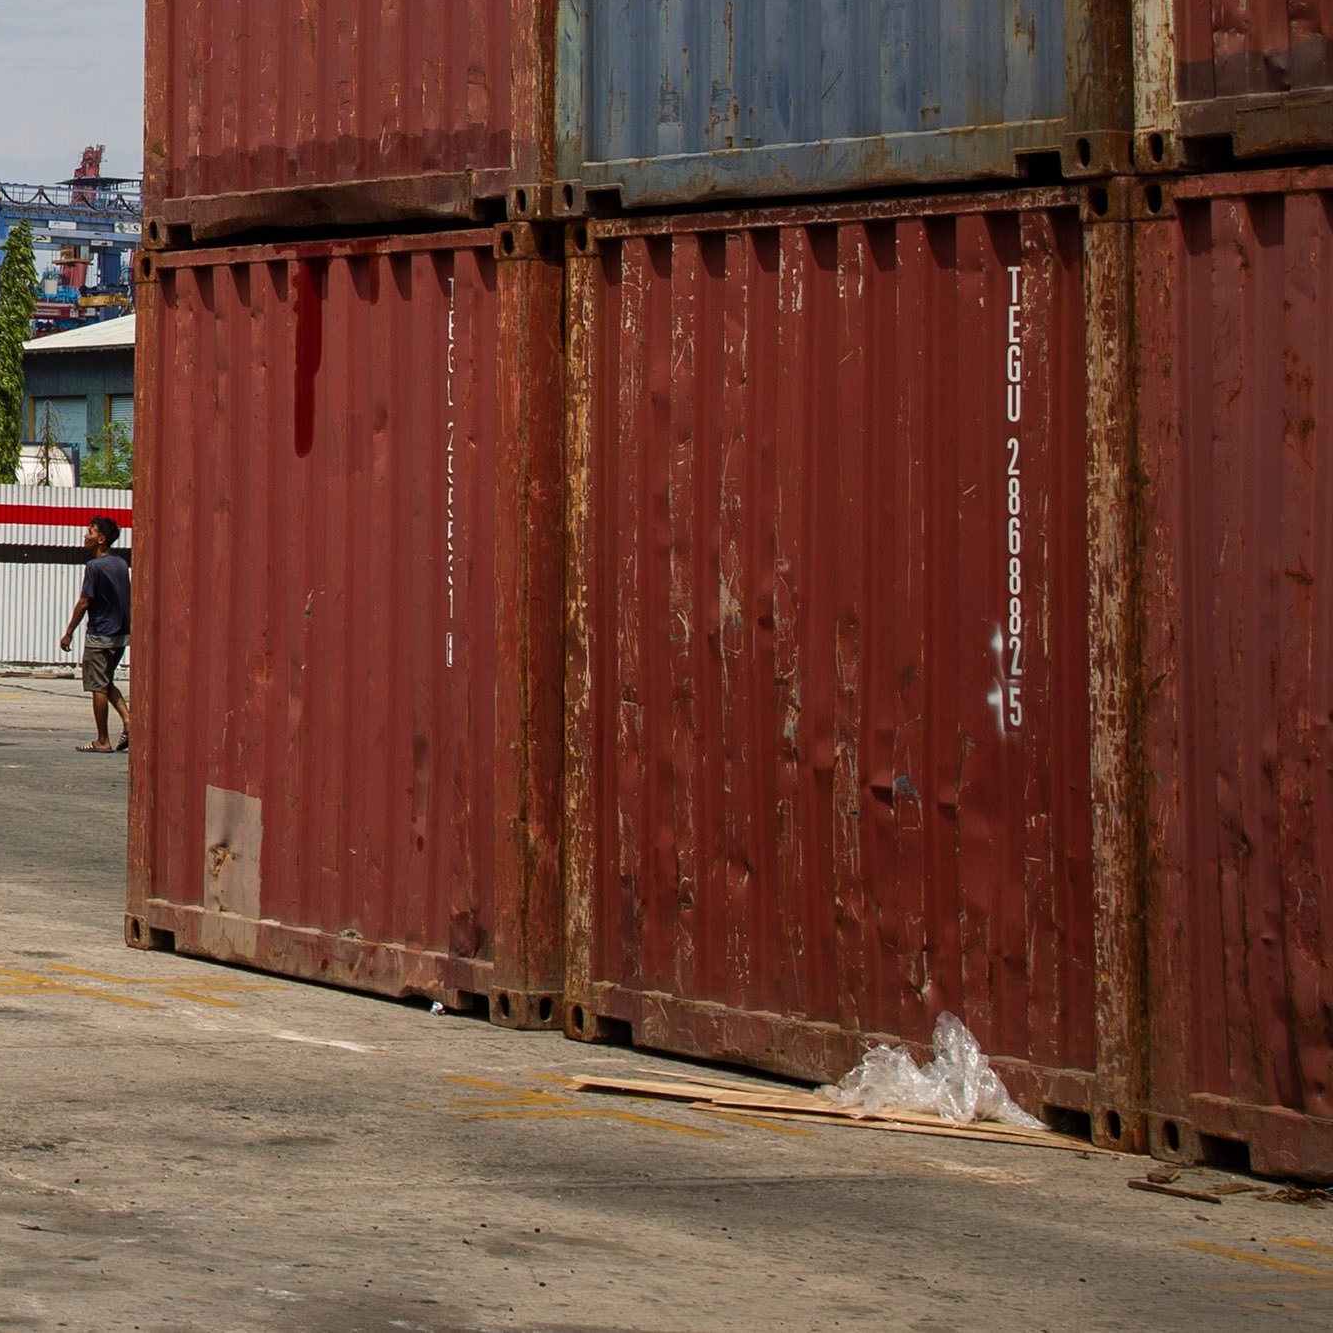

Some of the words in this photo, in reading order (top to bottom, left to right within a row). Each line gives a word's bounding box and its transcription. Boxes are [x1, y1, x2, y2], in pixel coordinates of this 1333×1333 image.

[1006, 266, 1022, 423] TEGU
[1007, 437, 1023, 676] 286882
[1008, 686, 1023, 726] 5
